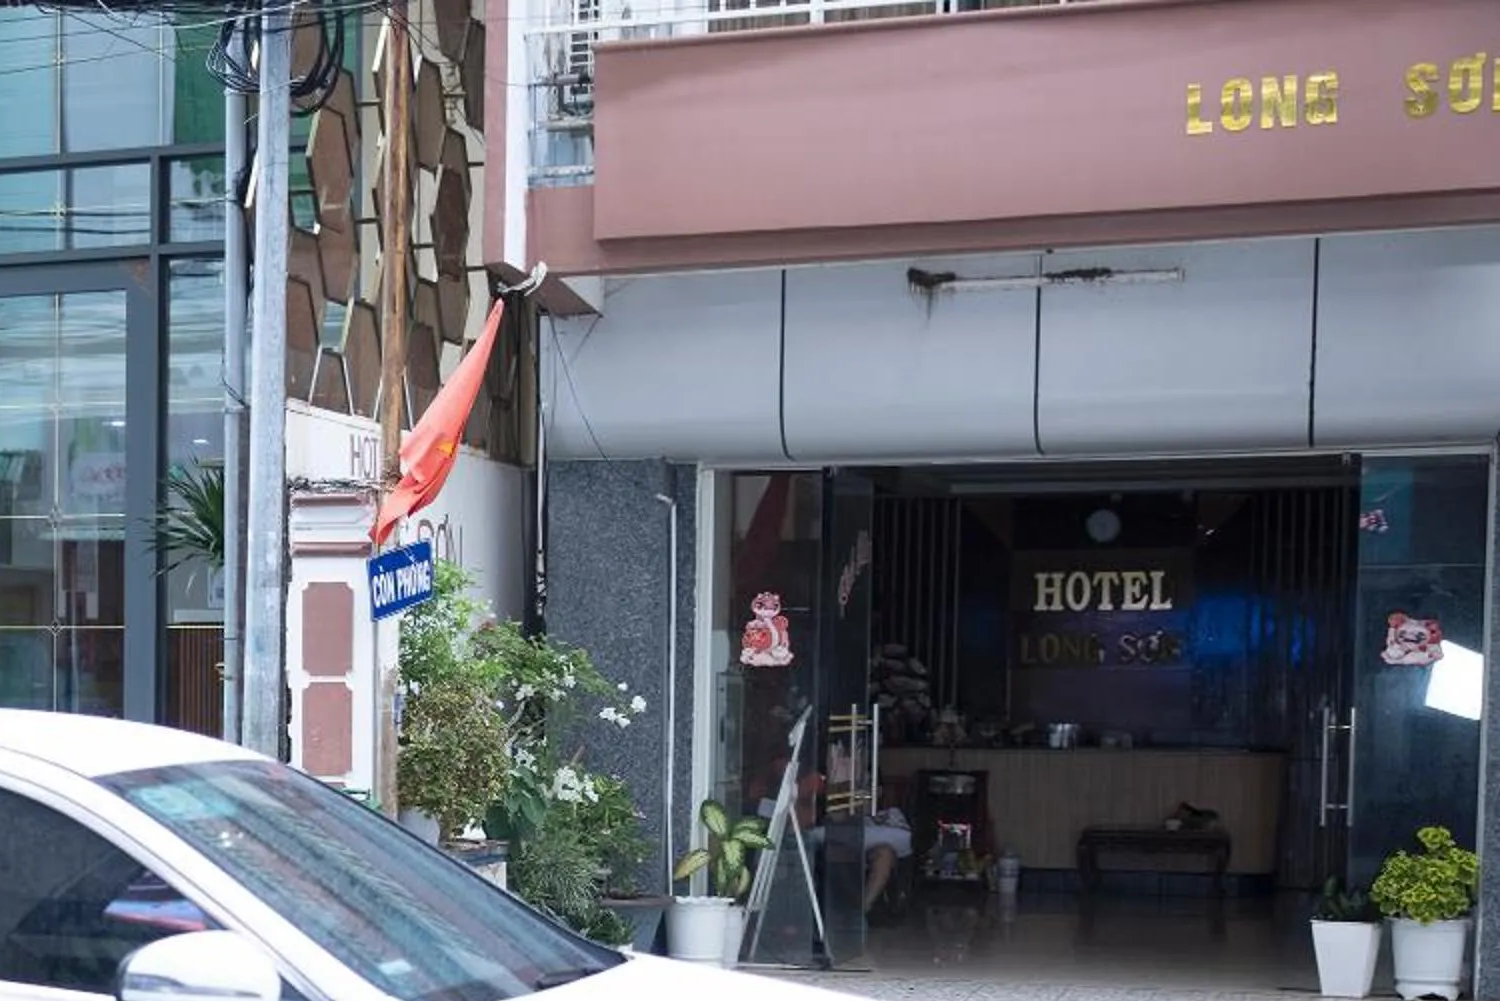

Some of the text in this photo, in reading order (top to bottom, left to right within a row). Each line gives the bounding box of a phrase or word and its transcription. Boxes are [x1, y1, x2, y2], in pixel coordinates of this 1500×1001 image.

[1185, 52, 1500, 136] LONG SƠ
[350, 434, 379, 480] HOT
[1033, 571, 1173, 612] HOTEL
[1019, 633, 1106, 665] LONG
